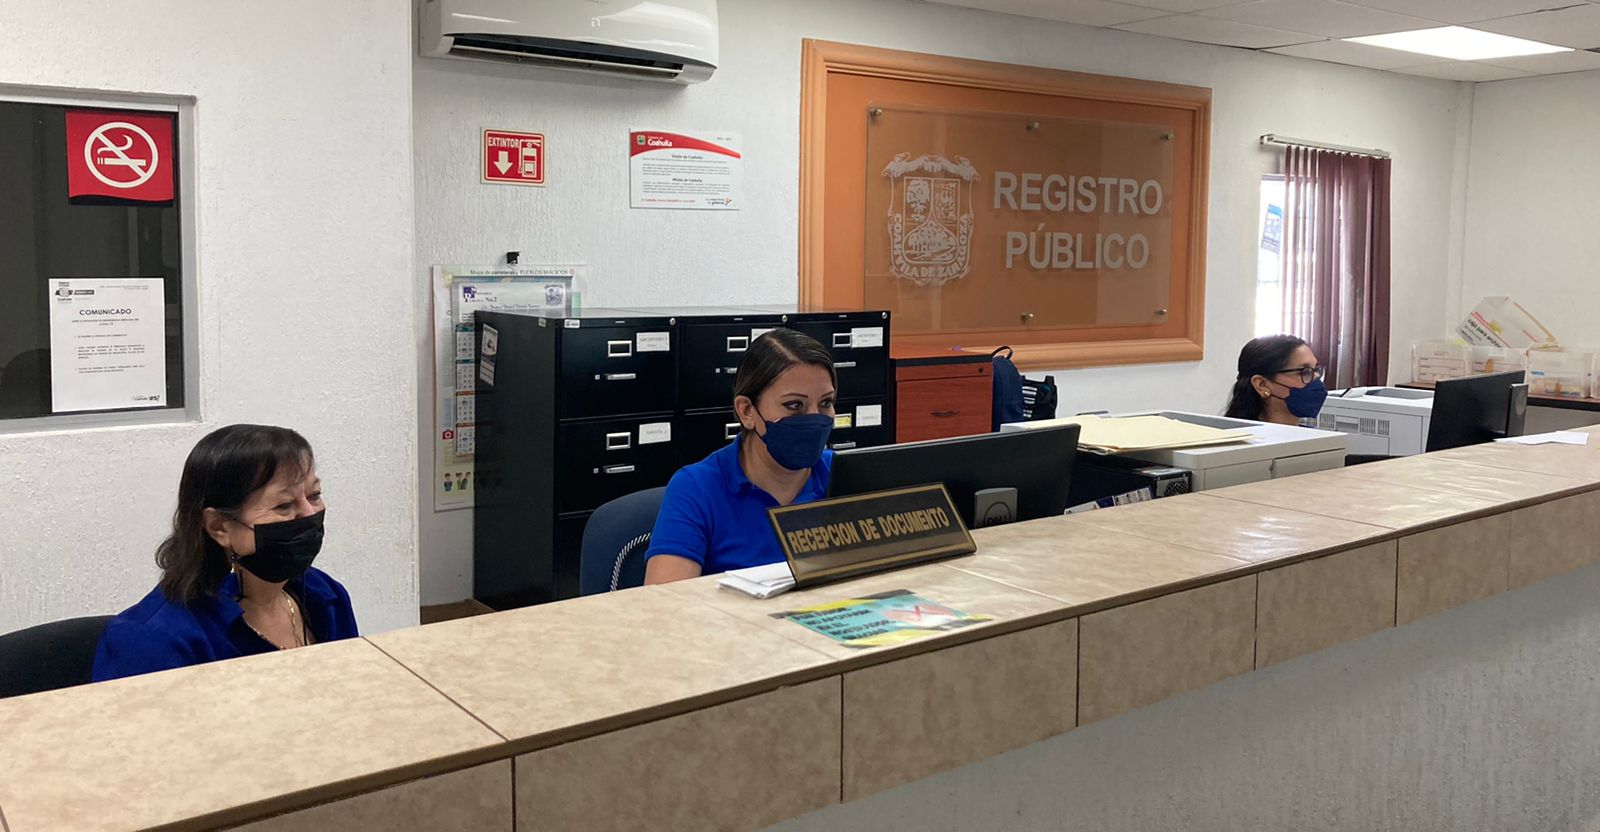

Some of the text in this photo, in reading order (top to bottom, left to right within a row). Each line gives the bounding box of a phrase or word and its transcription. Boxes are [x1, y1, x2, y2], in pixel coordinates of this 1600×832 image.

[488, 136, 520, 147] EXTINTOR
[647, 138, 673, 147] Coahuila
[993, 171, 1163, 215] REGISTRO
[1006, 223, 1151, 269] PÚBLICO
[79, 308, 132, 316] COMUNICADO
[787, 506, 950, 554] RECEPCION DE DOCUMENTO
